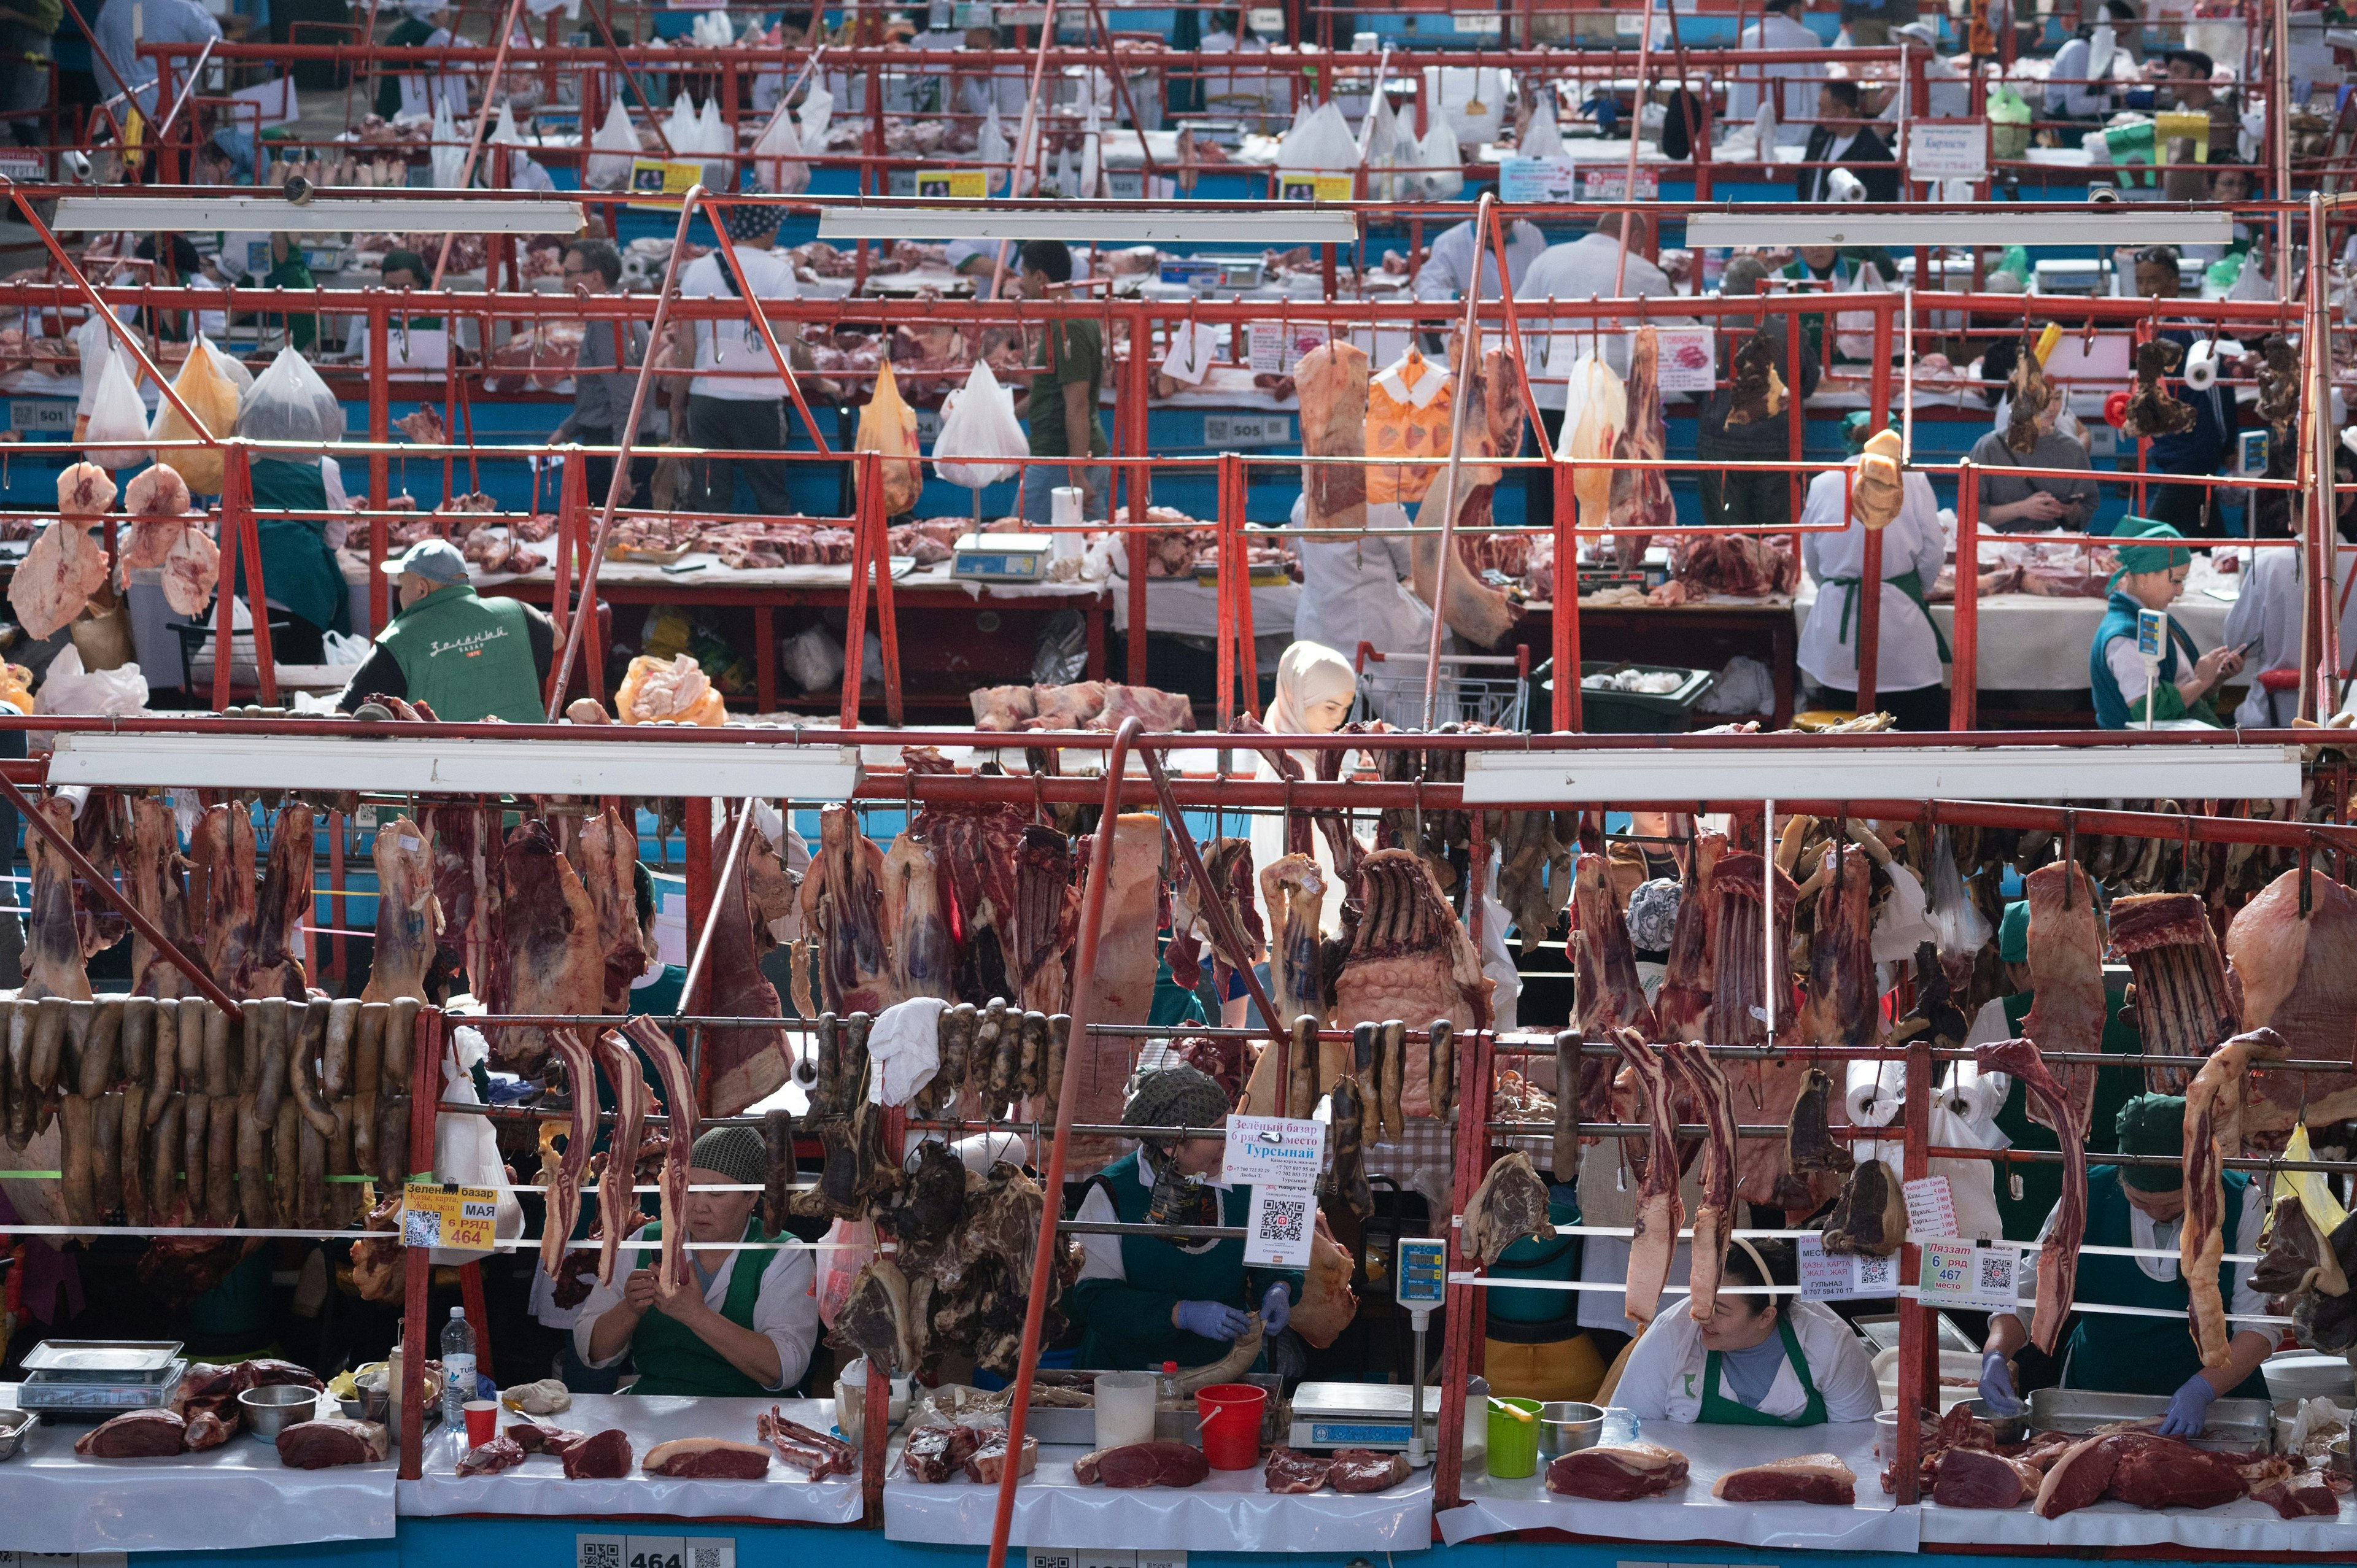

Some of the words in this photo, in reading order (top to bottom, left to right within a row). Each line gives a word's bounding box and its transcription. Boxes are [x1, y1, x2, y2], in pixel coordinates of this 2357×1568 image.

[40, 410, 63, 422] 501
[1233, 425, 1260, 436] 505
[1234, 1119, 1283, 1132] Зелёный
[1287, 1123, 1317, 1136] базар
[1231, 1131, 1237, 1140] 6
[1240, 1134, 1260, 1143] ряд
[1245, 1143, 1314, 1159] Турсынай
[462, 1188, 493, 1199] базар
[414, 1201, 435, 1210] Жал,
[465, 1205, 495, 1216] МАЯ
[460, 1219, 489, 1230] РЯД
[451, 1229, 481, 1244] 464
[1928, 1243, 1971, 1255] Ляззат
[1932, 1256, 1940, 1267] 6
[1948, 1259, 1968, 1269] ряд
[1939, 1269, 1961, 1280] 467
[630, 1553, 681, 1568] 464
